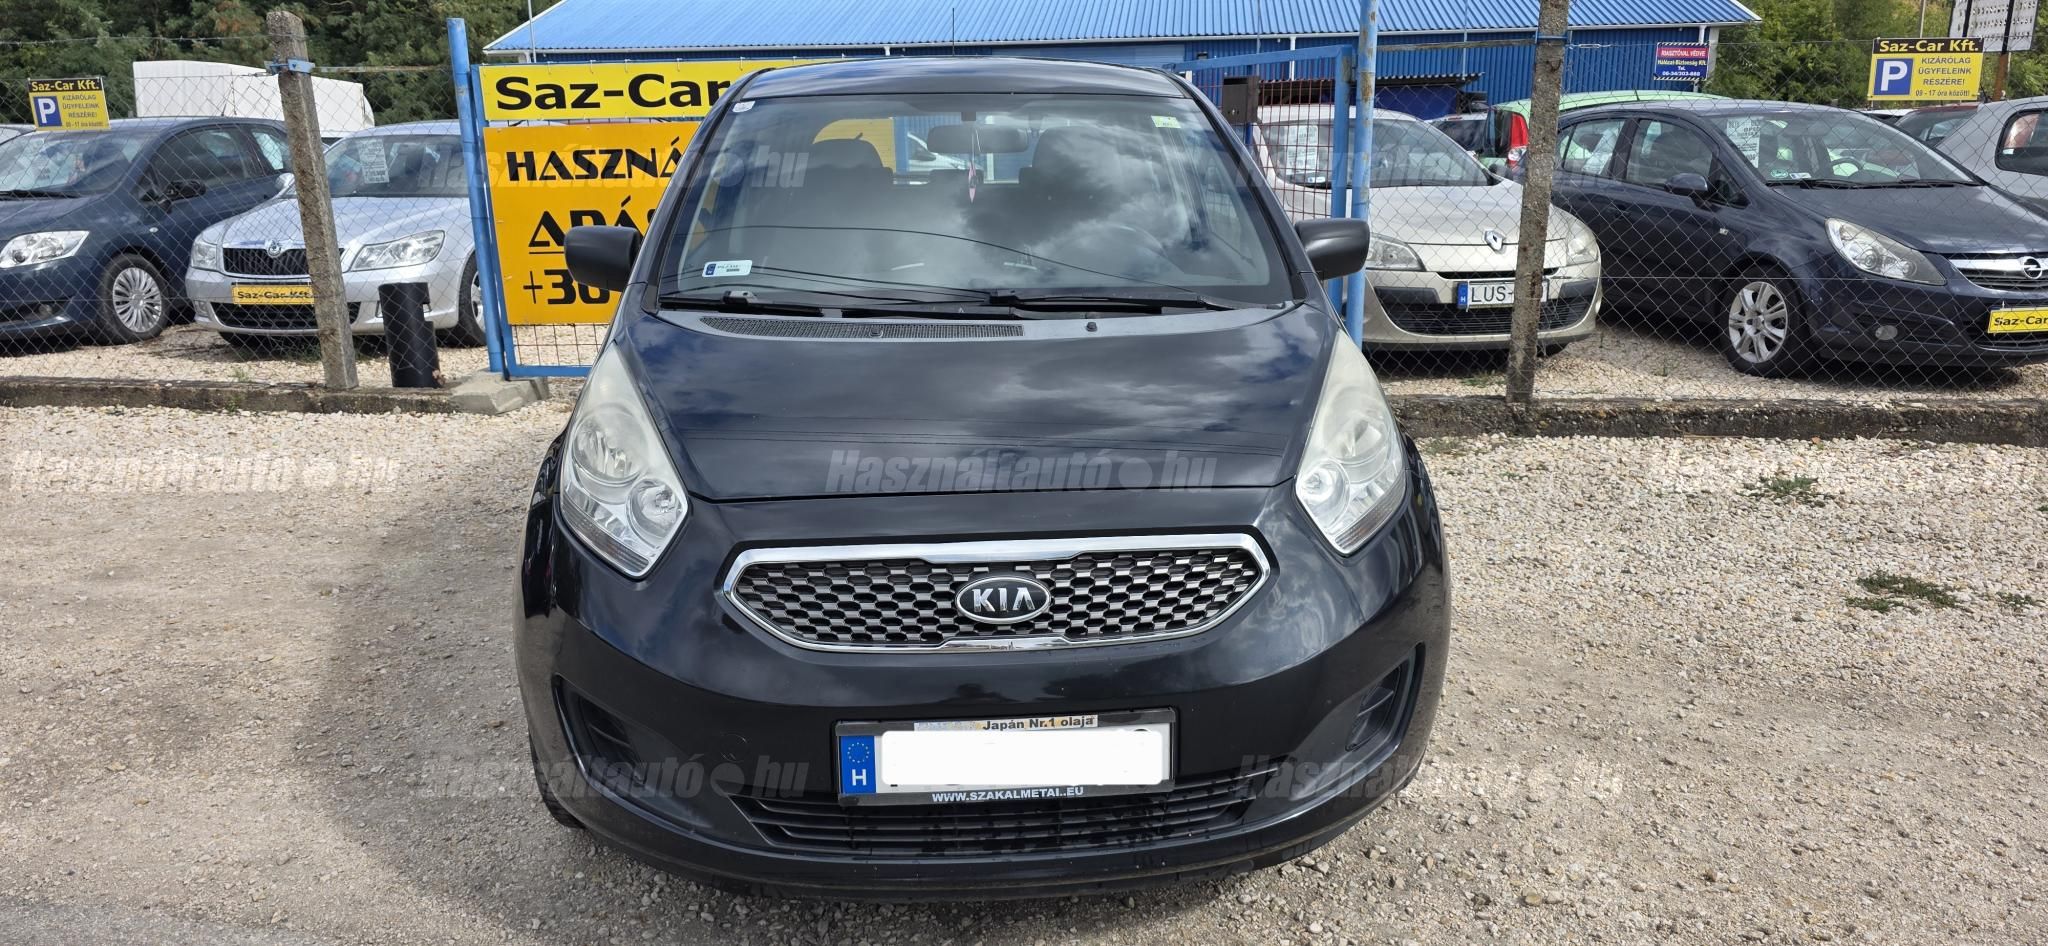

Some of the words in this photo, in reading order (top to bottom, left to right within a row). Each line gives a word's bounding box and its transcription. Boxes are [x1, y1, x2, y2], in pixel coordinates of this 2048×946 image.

[1879, 40, 1944, 52] Saz-Car
[1949, 39, 1979, 52] Kft.
[1921, 56, 1971, 64] KIZÁRÓLAG
[1880, 60, 1908, 92] P
[1918, 66, 1972, 75] ÜGYFELEINK
[31, 81, 75, 92] Saz-Car
[77, 79, 100, 90] Kft.
[495, 73, 730, 110] Saz-Car
[37, 97, 56, 124] P
[528, 195, 656, 248] AÁ
[972, 587, 1036, 613] KIA
[982, 719, 1024, 731] Japán
[1029, 717, 1055, 729] Nr.1
[851, 768, 867, 786] H
